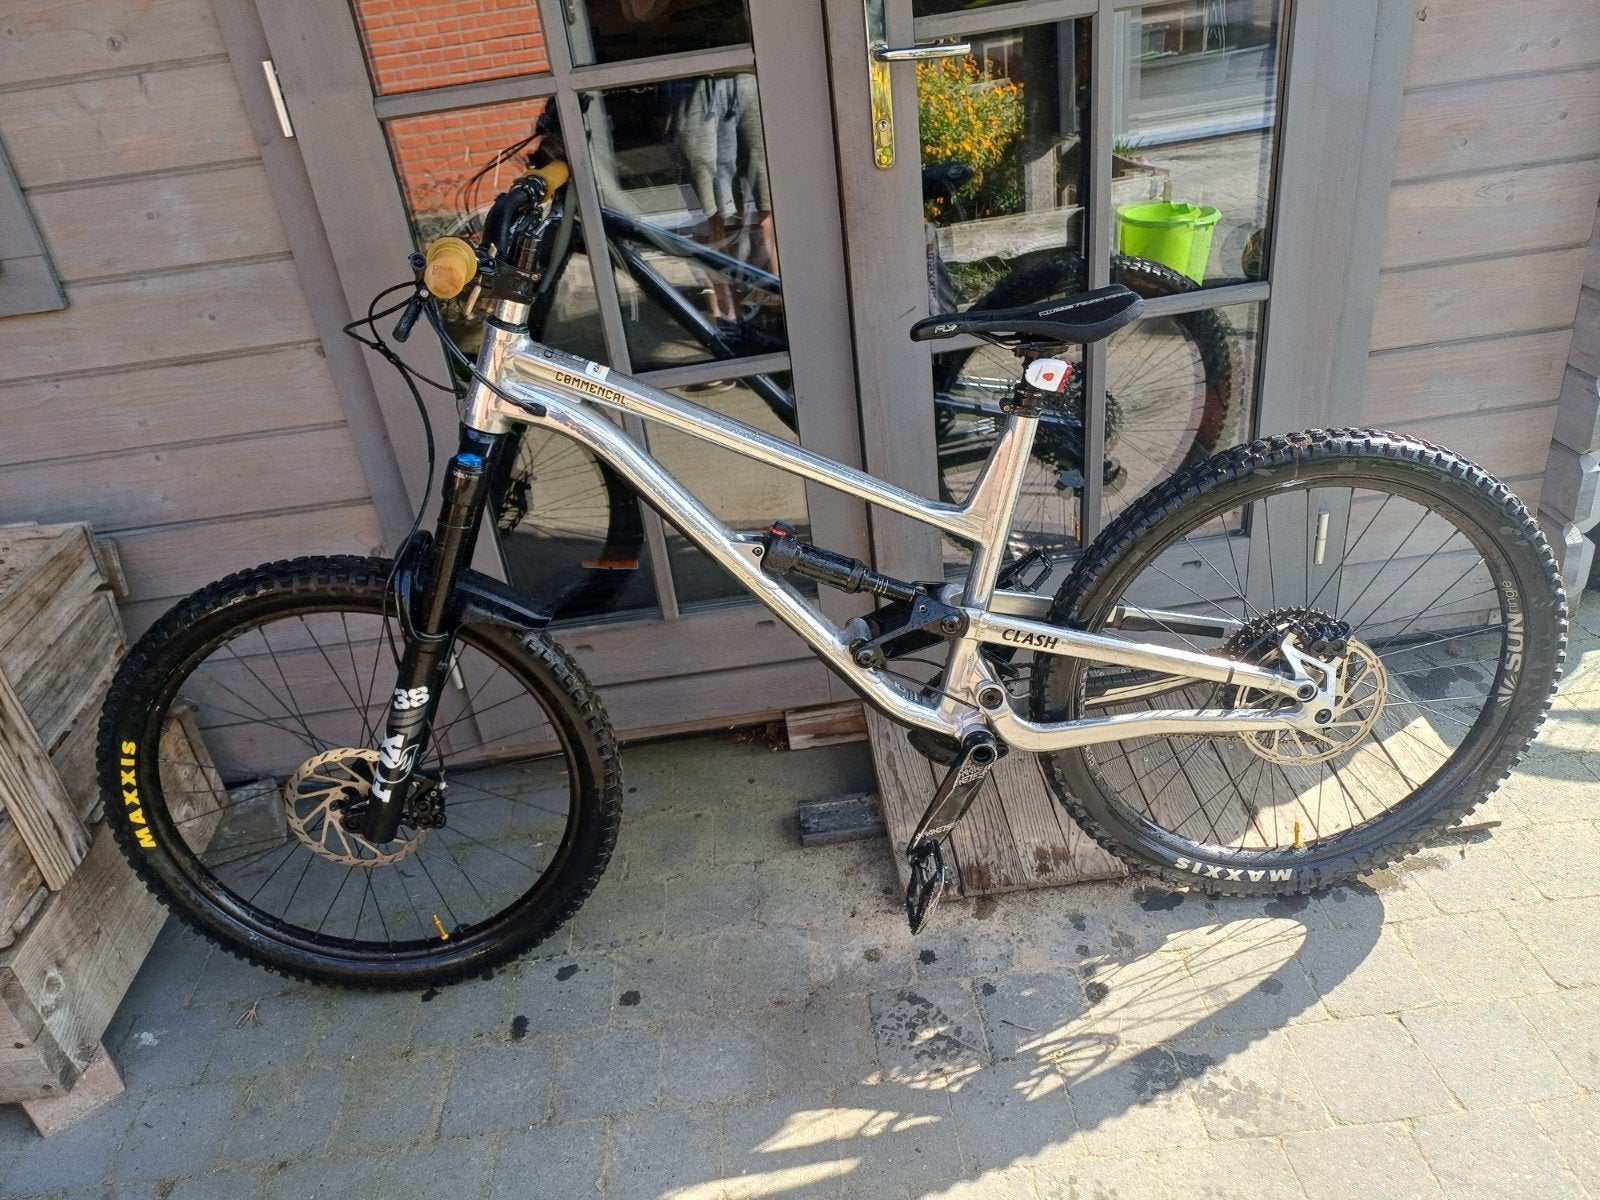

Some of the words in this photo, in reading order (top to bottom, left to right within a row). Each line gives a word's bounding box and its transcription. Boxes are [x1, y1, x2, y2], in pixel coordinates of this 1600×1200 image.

[1002, 628, 1059, 649] CLASH
[1504, 613, 1524, 672] SUN
[120, 741, 157, 848] MAXXIS
[1174, 857, 1293, 882] MAXXIS
